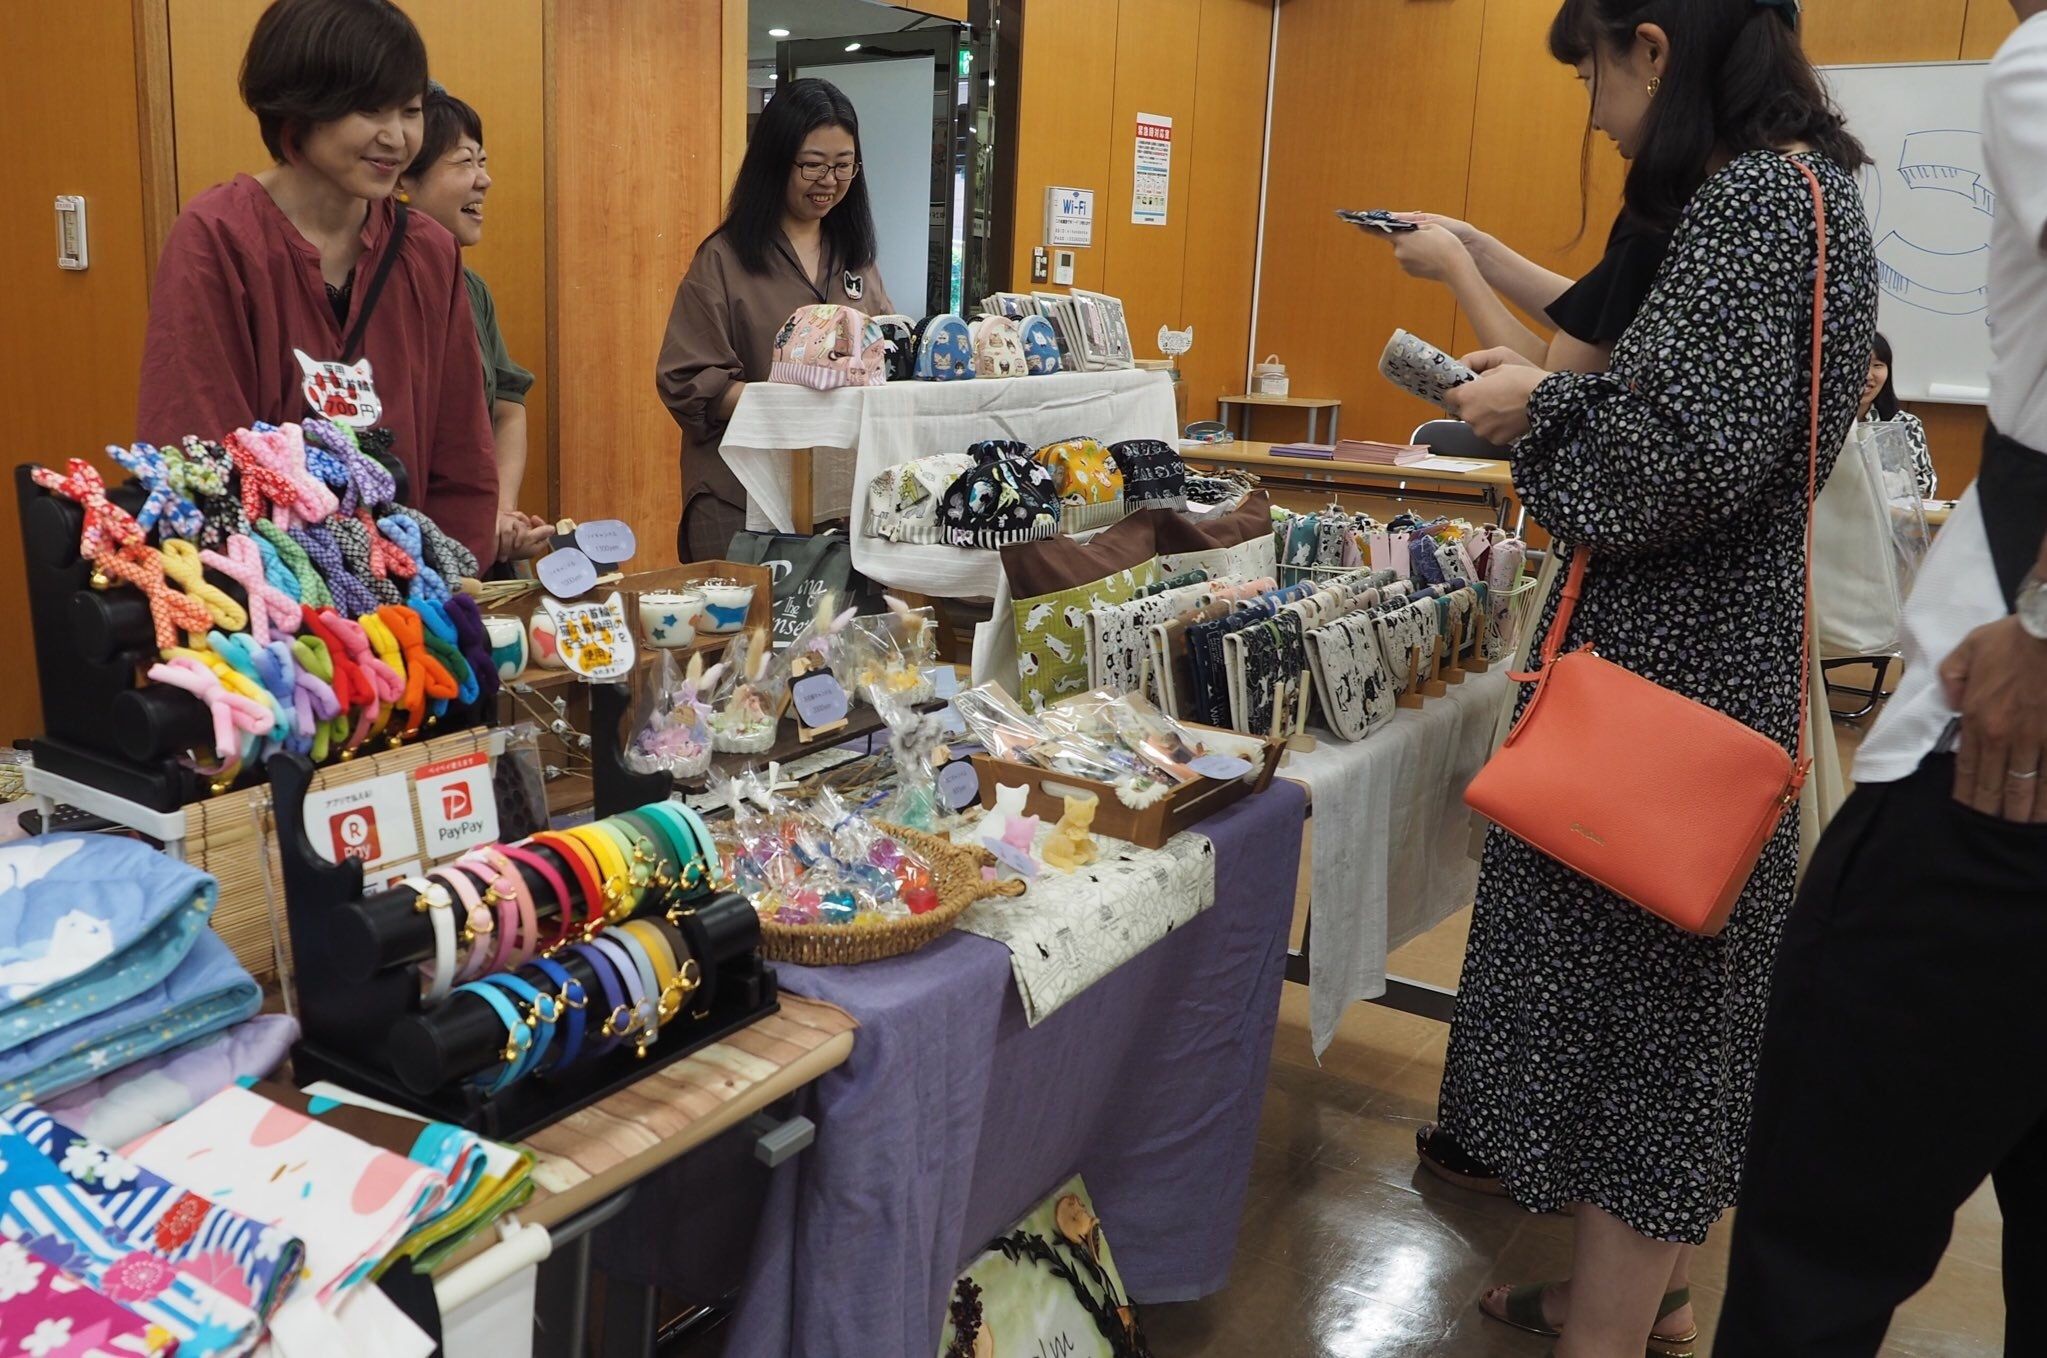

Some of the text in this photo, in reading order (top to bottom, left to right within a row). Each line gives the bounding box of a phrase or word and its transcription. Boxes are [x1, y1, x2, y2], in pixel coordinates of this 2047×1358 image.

[1063, 199, 1087, 215] Wi-Fi
[783, 597, 800, 615] The
[349, 822, 361, 838] R
[439, 821, 483, 841] PayPay
